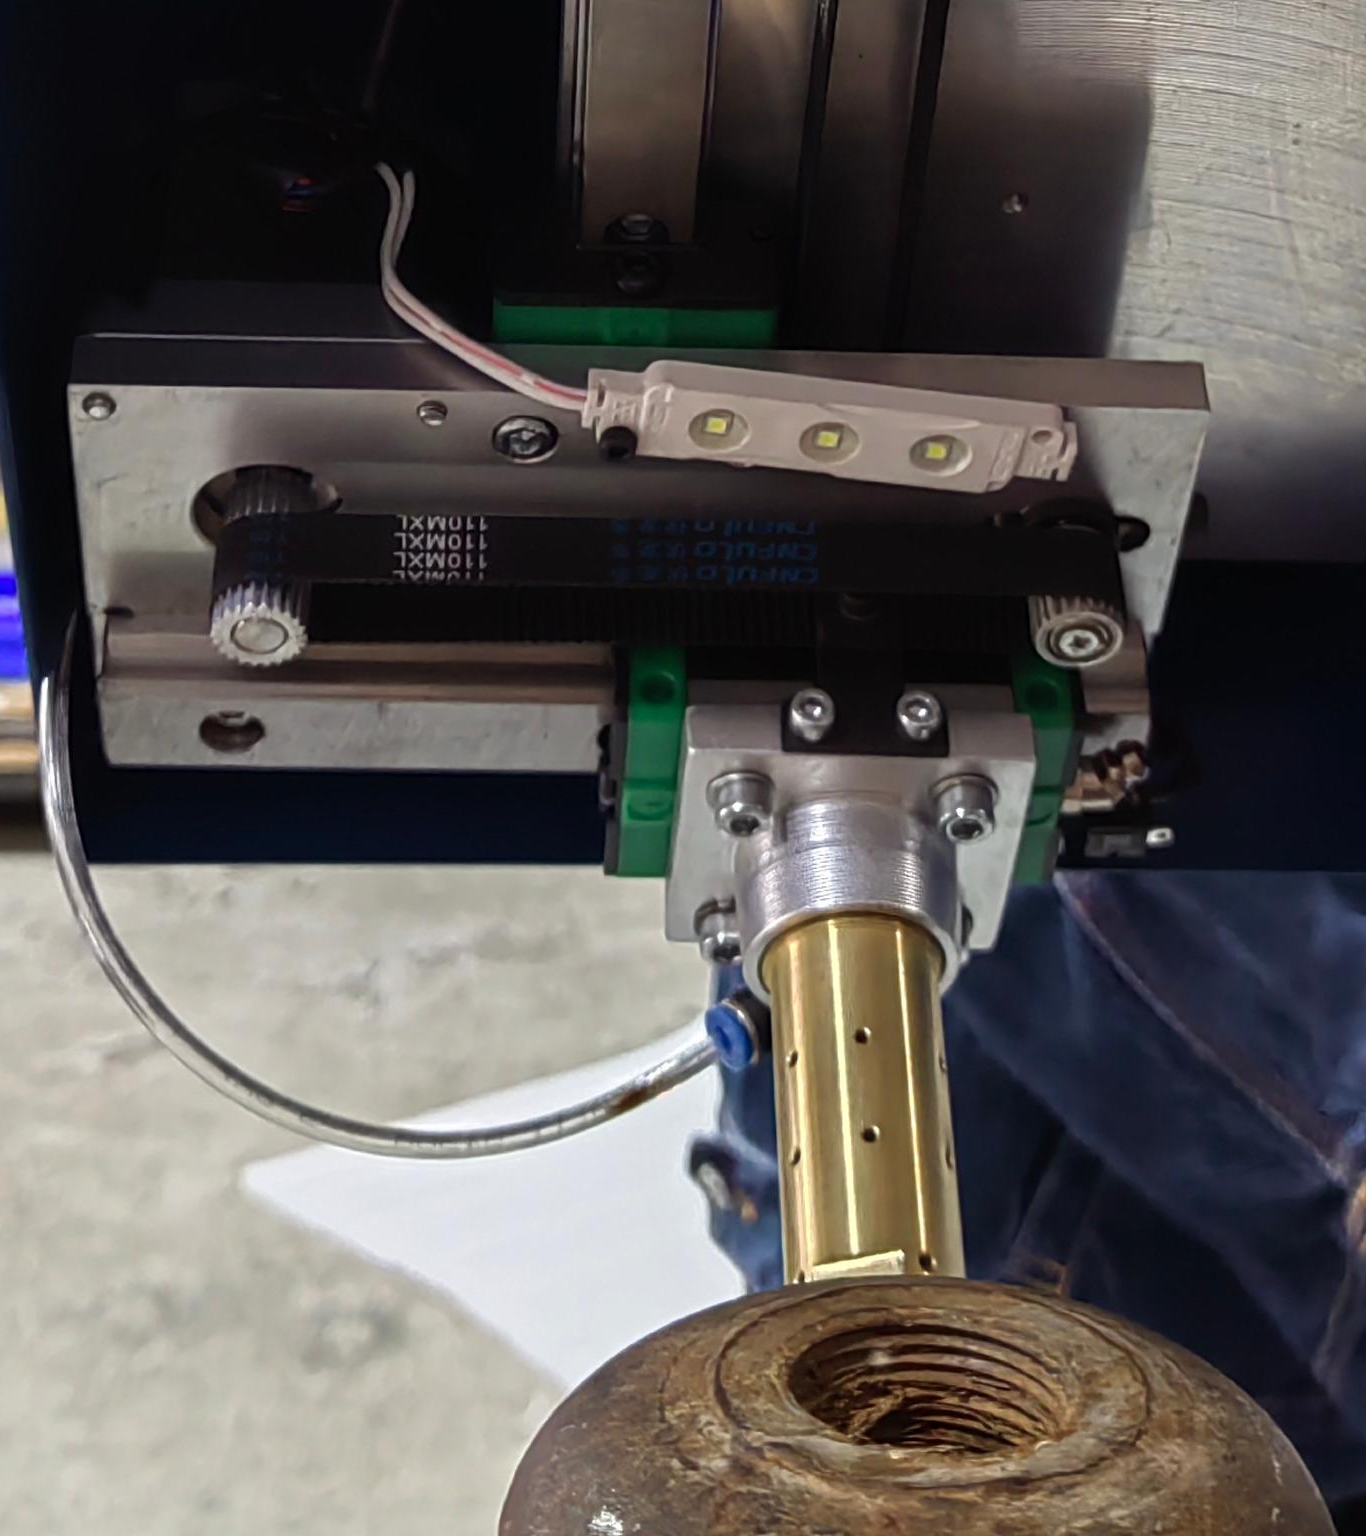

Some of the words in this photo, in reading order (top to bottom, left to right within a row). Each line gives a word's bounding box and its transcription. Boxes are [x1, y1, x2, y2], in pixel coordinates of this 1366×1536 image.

[397, 515, 488, 531] 110MXL
[394, 533, 488, 550] 110MXL
[393, 552, 487, 569] 110MXL
